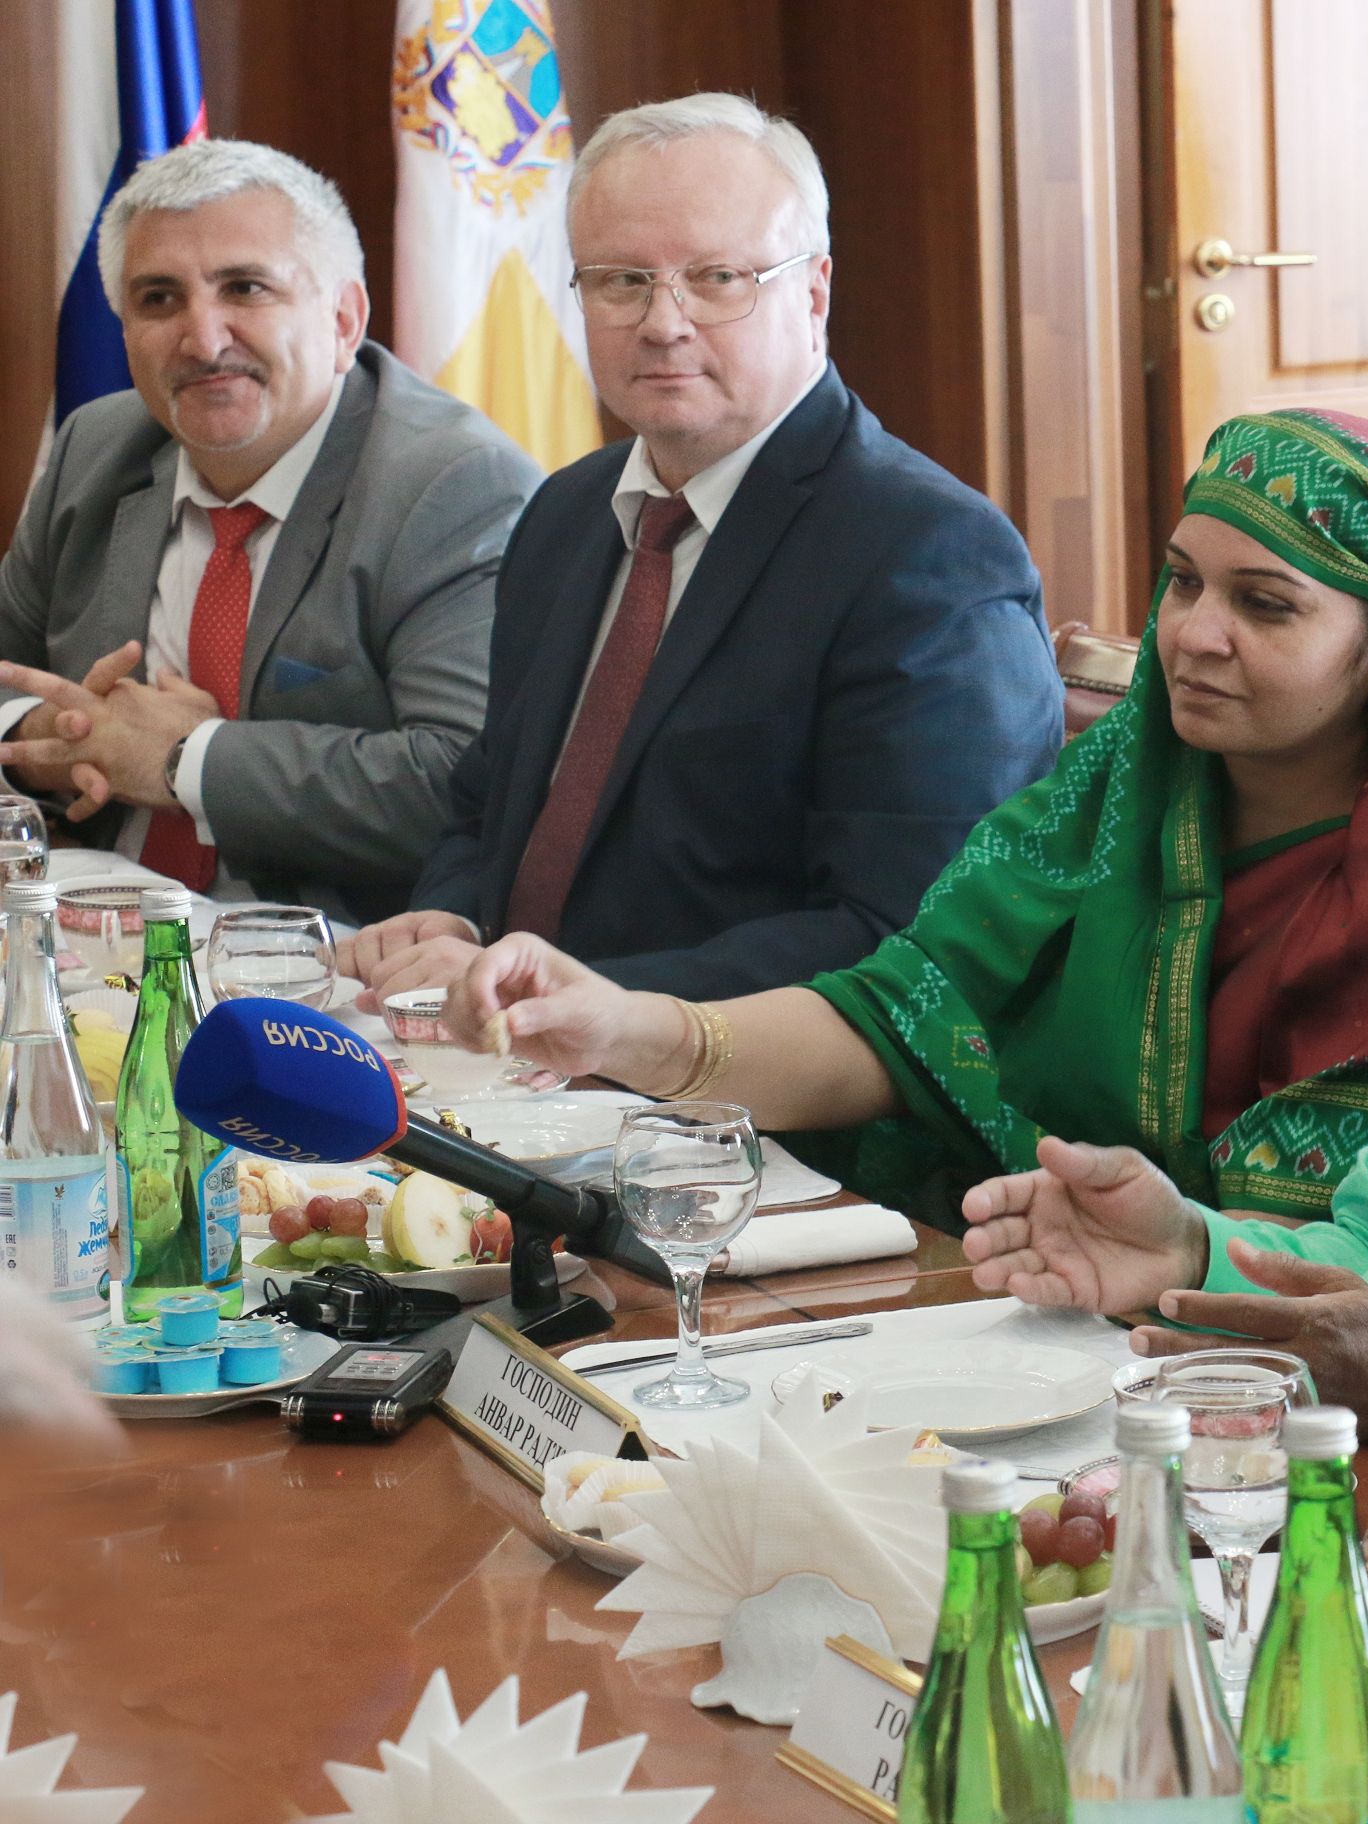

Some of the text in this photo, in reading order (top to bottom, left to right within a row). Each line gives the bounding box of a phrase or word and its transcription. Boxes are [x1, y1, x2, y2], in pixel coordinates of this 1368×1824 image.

[262, 1019, 381, 1072] РОССИЯ
[217, 1116, 338, 1163] ОССИЯ
[474, 1392, 524, 1443] АНВАР
[501, 1353, 583, 1431] ГОСПОДИН
[875, 1700, 911, 1741] ГО
